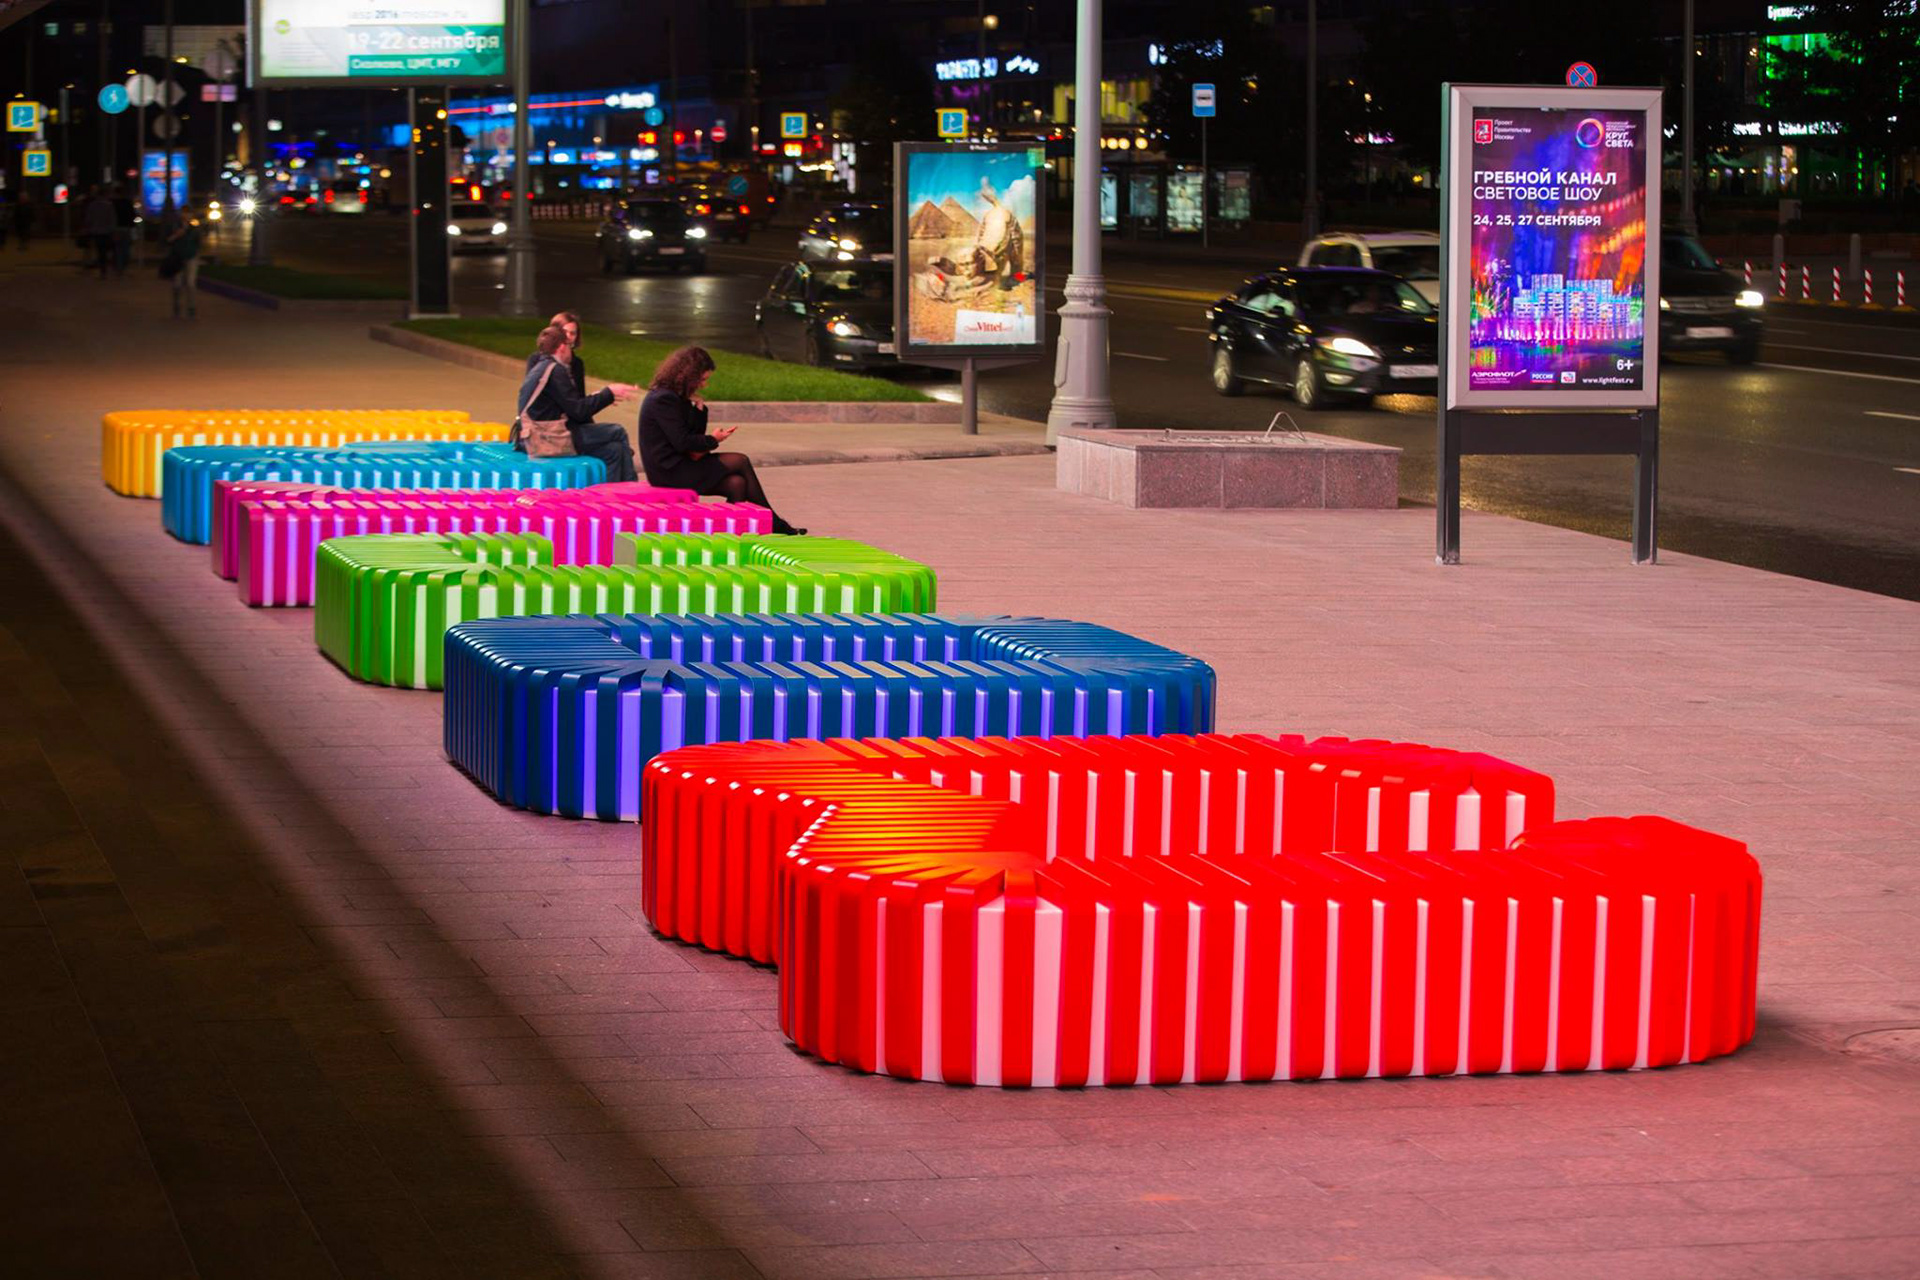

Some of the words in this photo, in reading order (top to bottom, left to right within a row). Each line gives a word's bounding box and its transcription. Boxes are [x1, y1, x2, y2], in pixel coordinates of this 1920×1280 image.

[348, 32, 404, 49] 19-22
[407, 31, 500, 52] сентября
[1605, 131, 1629, 140] КРУГ
[1605, 139, 1634, 148] СВЕТА
[1474, 168, 1551, 184] ГРЕБНОЙ
[1557, 172, 1617, 185] КАНАЛ
[1473, 187, 1560, 200] СВЕТОВОЕ
[1564, 187, 1603, 201] ШОУ
[1473, 215, 1493, 226] 24,
[1496, 215, 1515, 226] 25,
[1518, 215, 1533, 226] 27
[1536, 215, 1602, 226] СЕНТЯБРЯ
[977, 322, 1003, 332] Vittel
[1616, 359, 1634, 371] 6+
[1582, 377, 1635, 385] www.lightfest.ru
